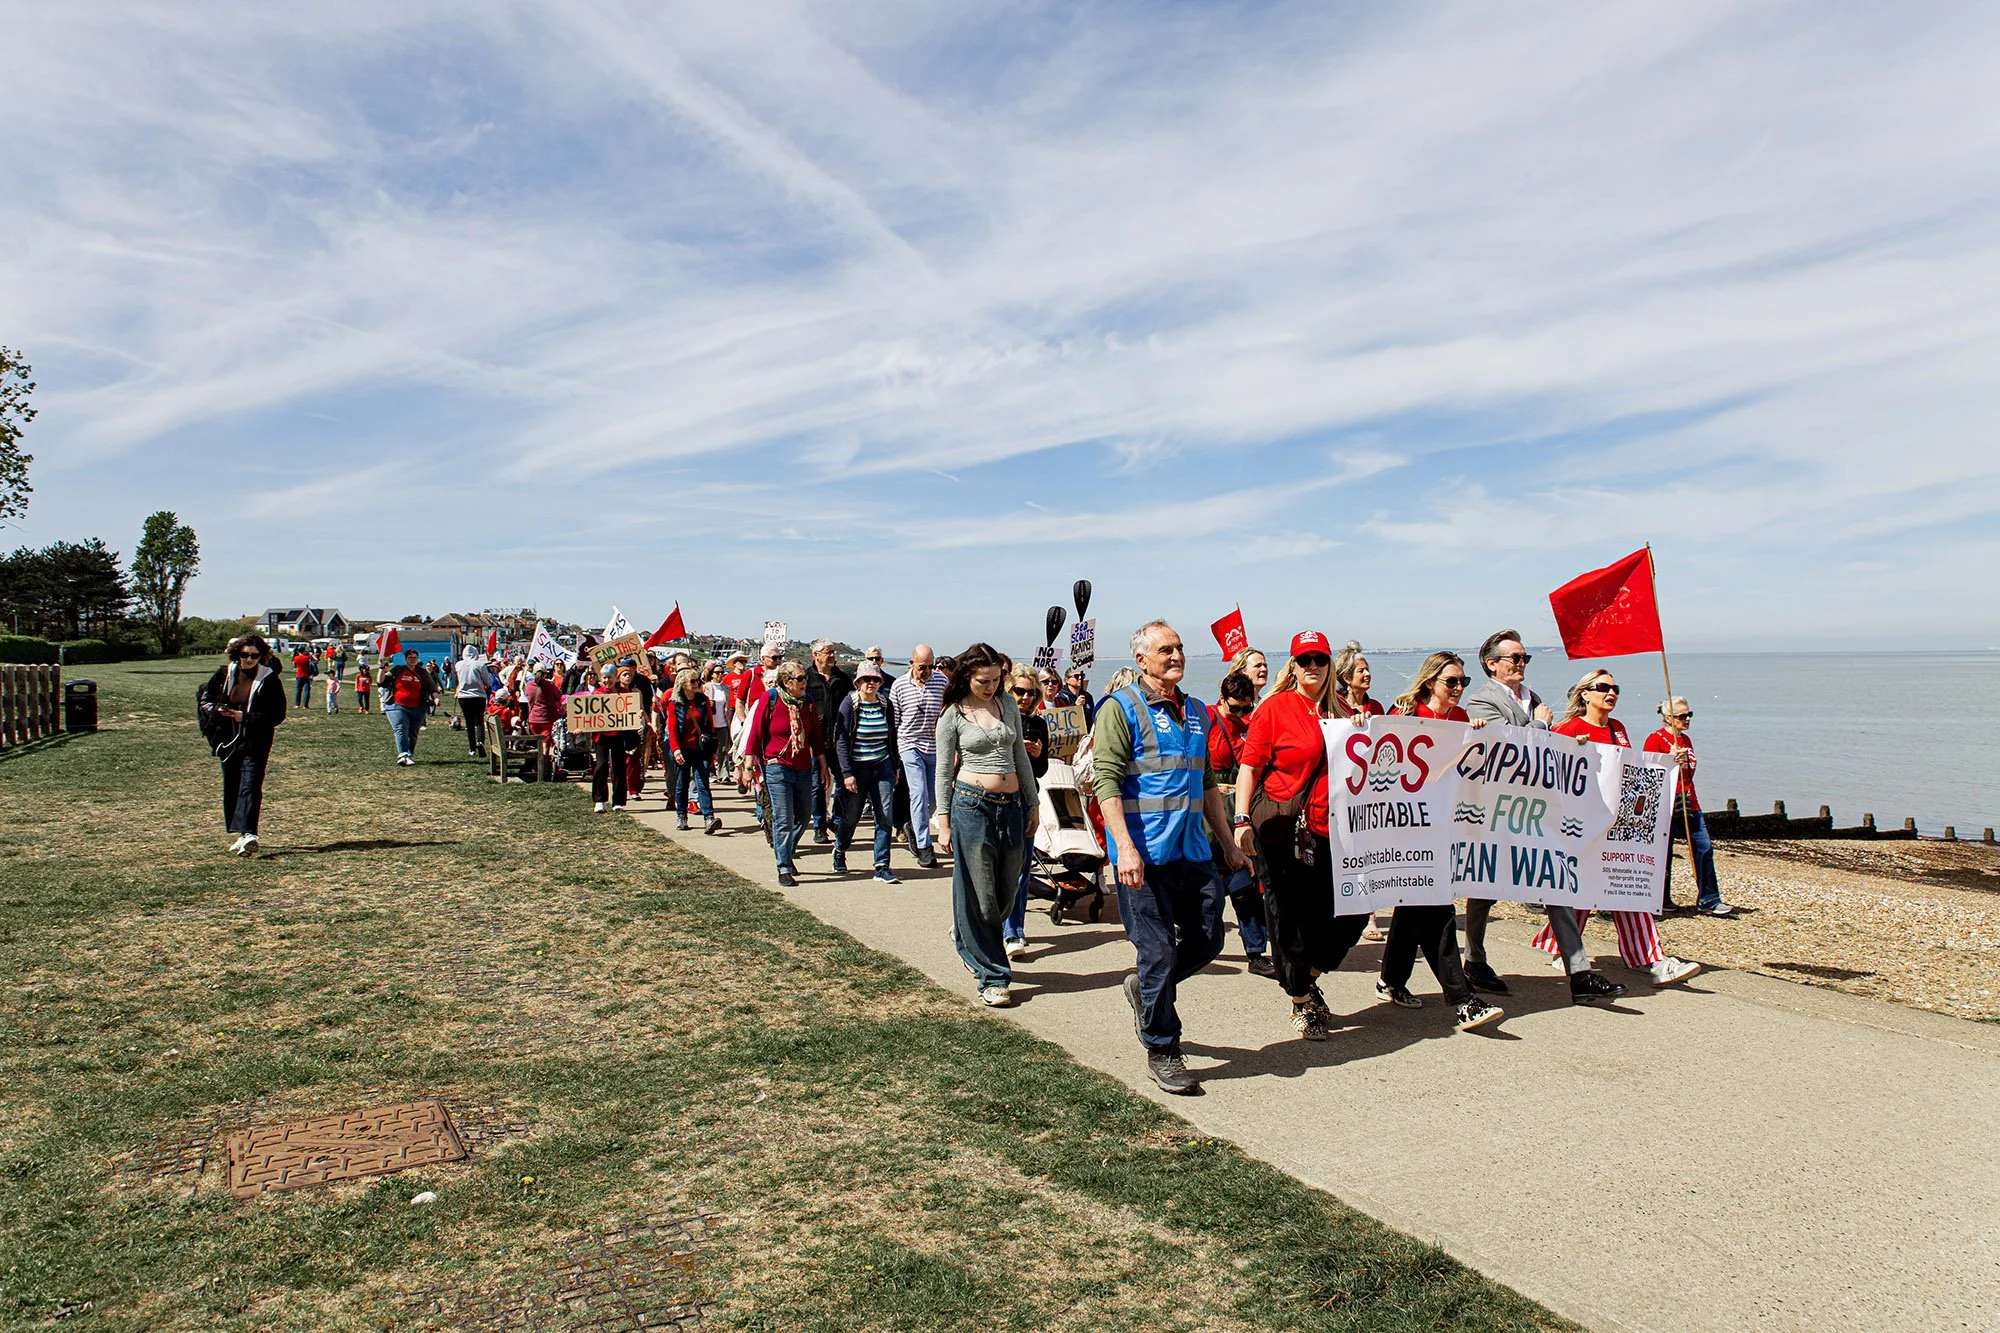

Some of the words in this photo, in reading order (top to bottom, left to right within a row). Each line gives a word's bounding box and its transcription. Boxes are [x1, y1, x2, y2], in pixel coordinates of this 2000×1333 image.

[537, 632, 573, 662] SAVE
[595, 646, 618, 665] END
[615, 637, 639, 656] THIS
[1038, 646, 1055, 658] NO
[1032, 656, 1058, 669] MORE
[573, 696, 611, 715] SICK
[615, 695, 633, 713] OF
[573, 714, 606, 729] THIS
[607, 711, 637, 728] SHIT
[1044, 709, 1080, 733] BLIC
[1345, 733, 1435, 796] SOS
[1347, 801, 1431, 833] WHITSTABLE
[1489, 793, 1548, 837] FOR
[1510, 845, 1579, 894] WATS
[1601, 851, 1635, 862] SUPPORT
[1637, 854, 1645, 863] US
